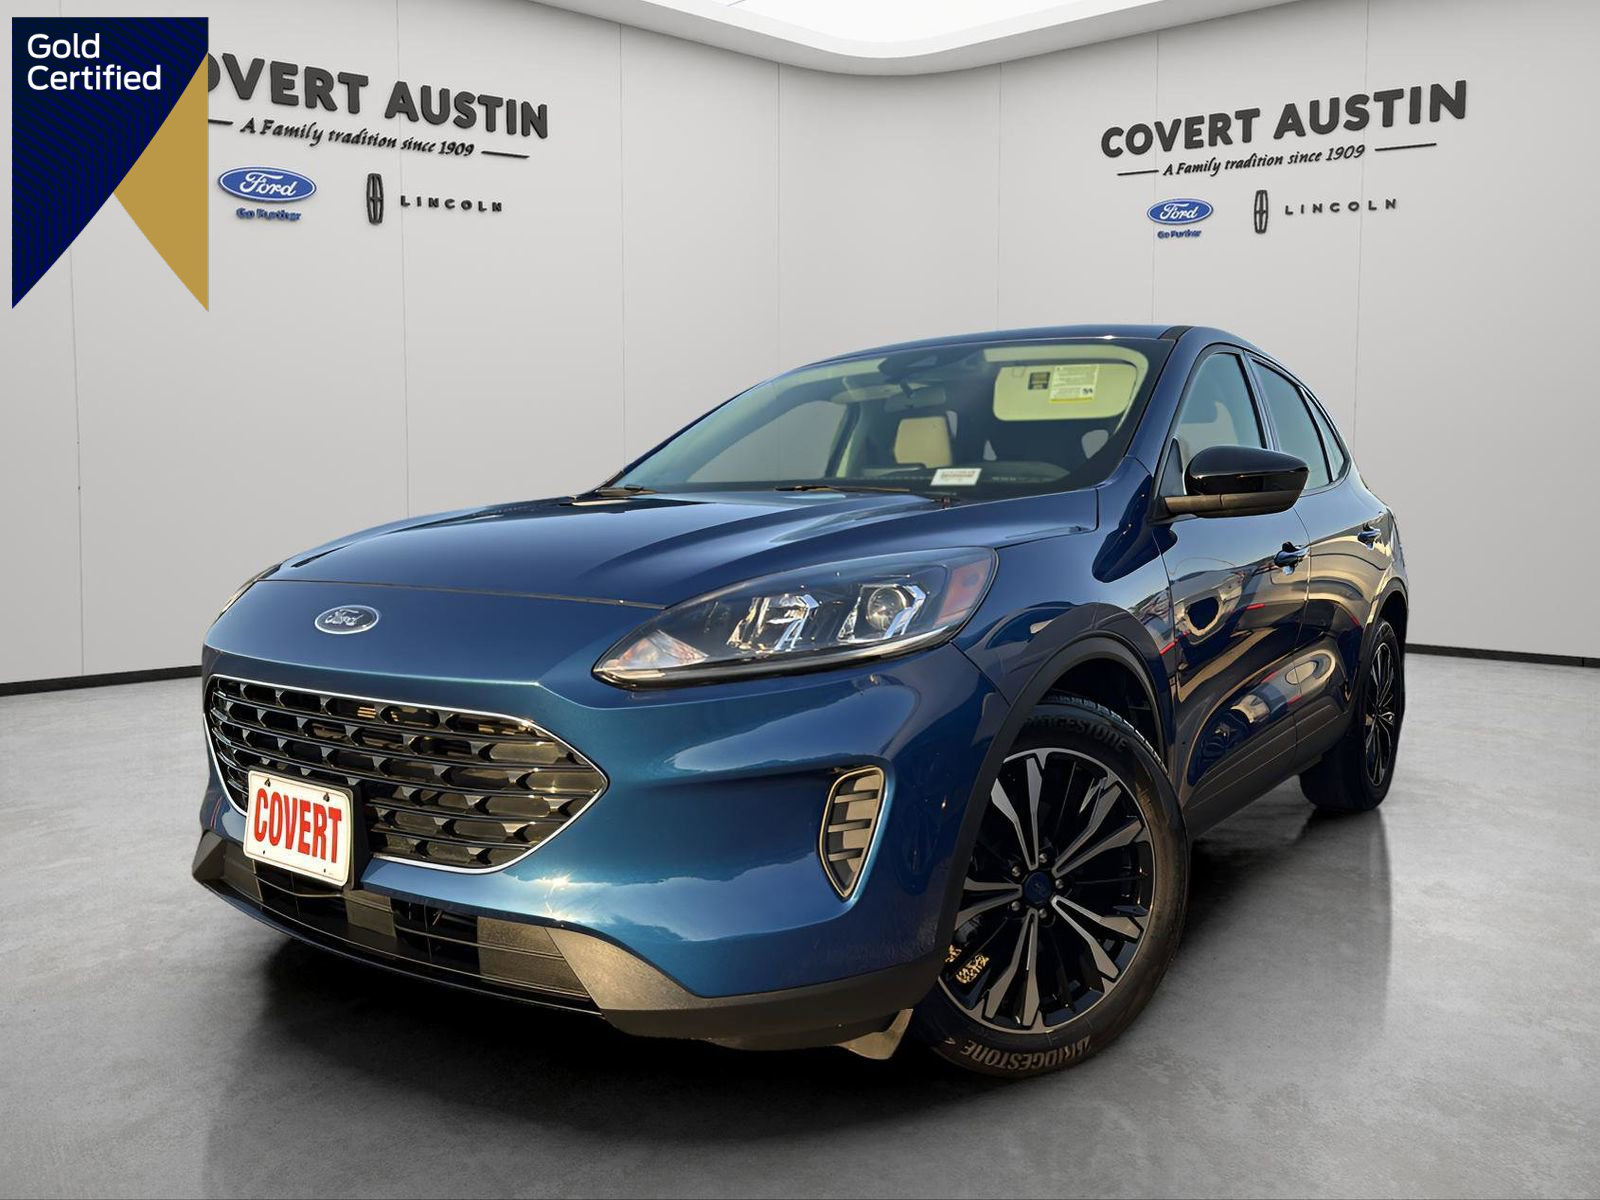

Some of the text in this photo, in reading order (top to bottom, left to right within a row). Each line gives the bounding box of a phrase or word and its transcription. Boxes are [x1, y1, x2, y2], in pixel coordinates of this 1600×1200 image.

[208, 52, 549, 140] VERT AUSTIN
[1101, 79, 1467, 159] COVERT AUSTIN
[240, 117, 475, 157] A Family tradition since 1909
[1162, 144, 1366, 177] A Family tradition since 1909
[239, 171, 298, 196] Ford
[400, 195, 503, 213] LINCOLN
[1160, 203, 1200, 220] Ford
[1284, 198, 1397, 216] LINCOLN
[253, 787, 343, 864] COVERT
